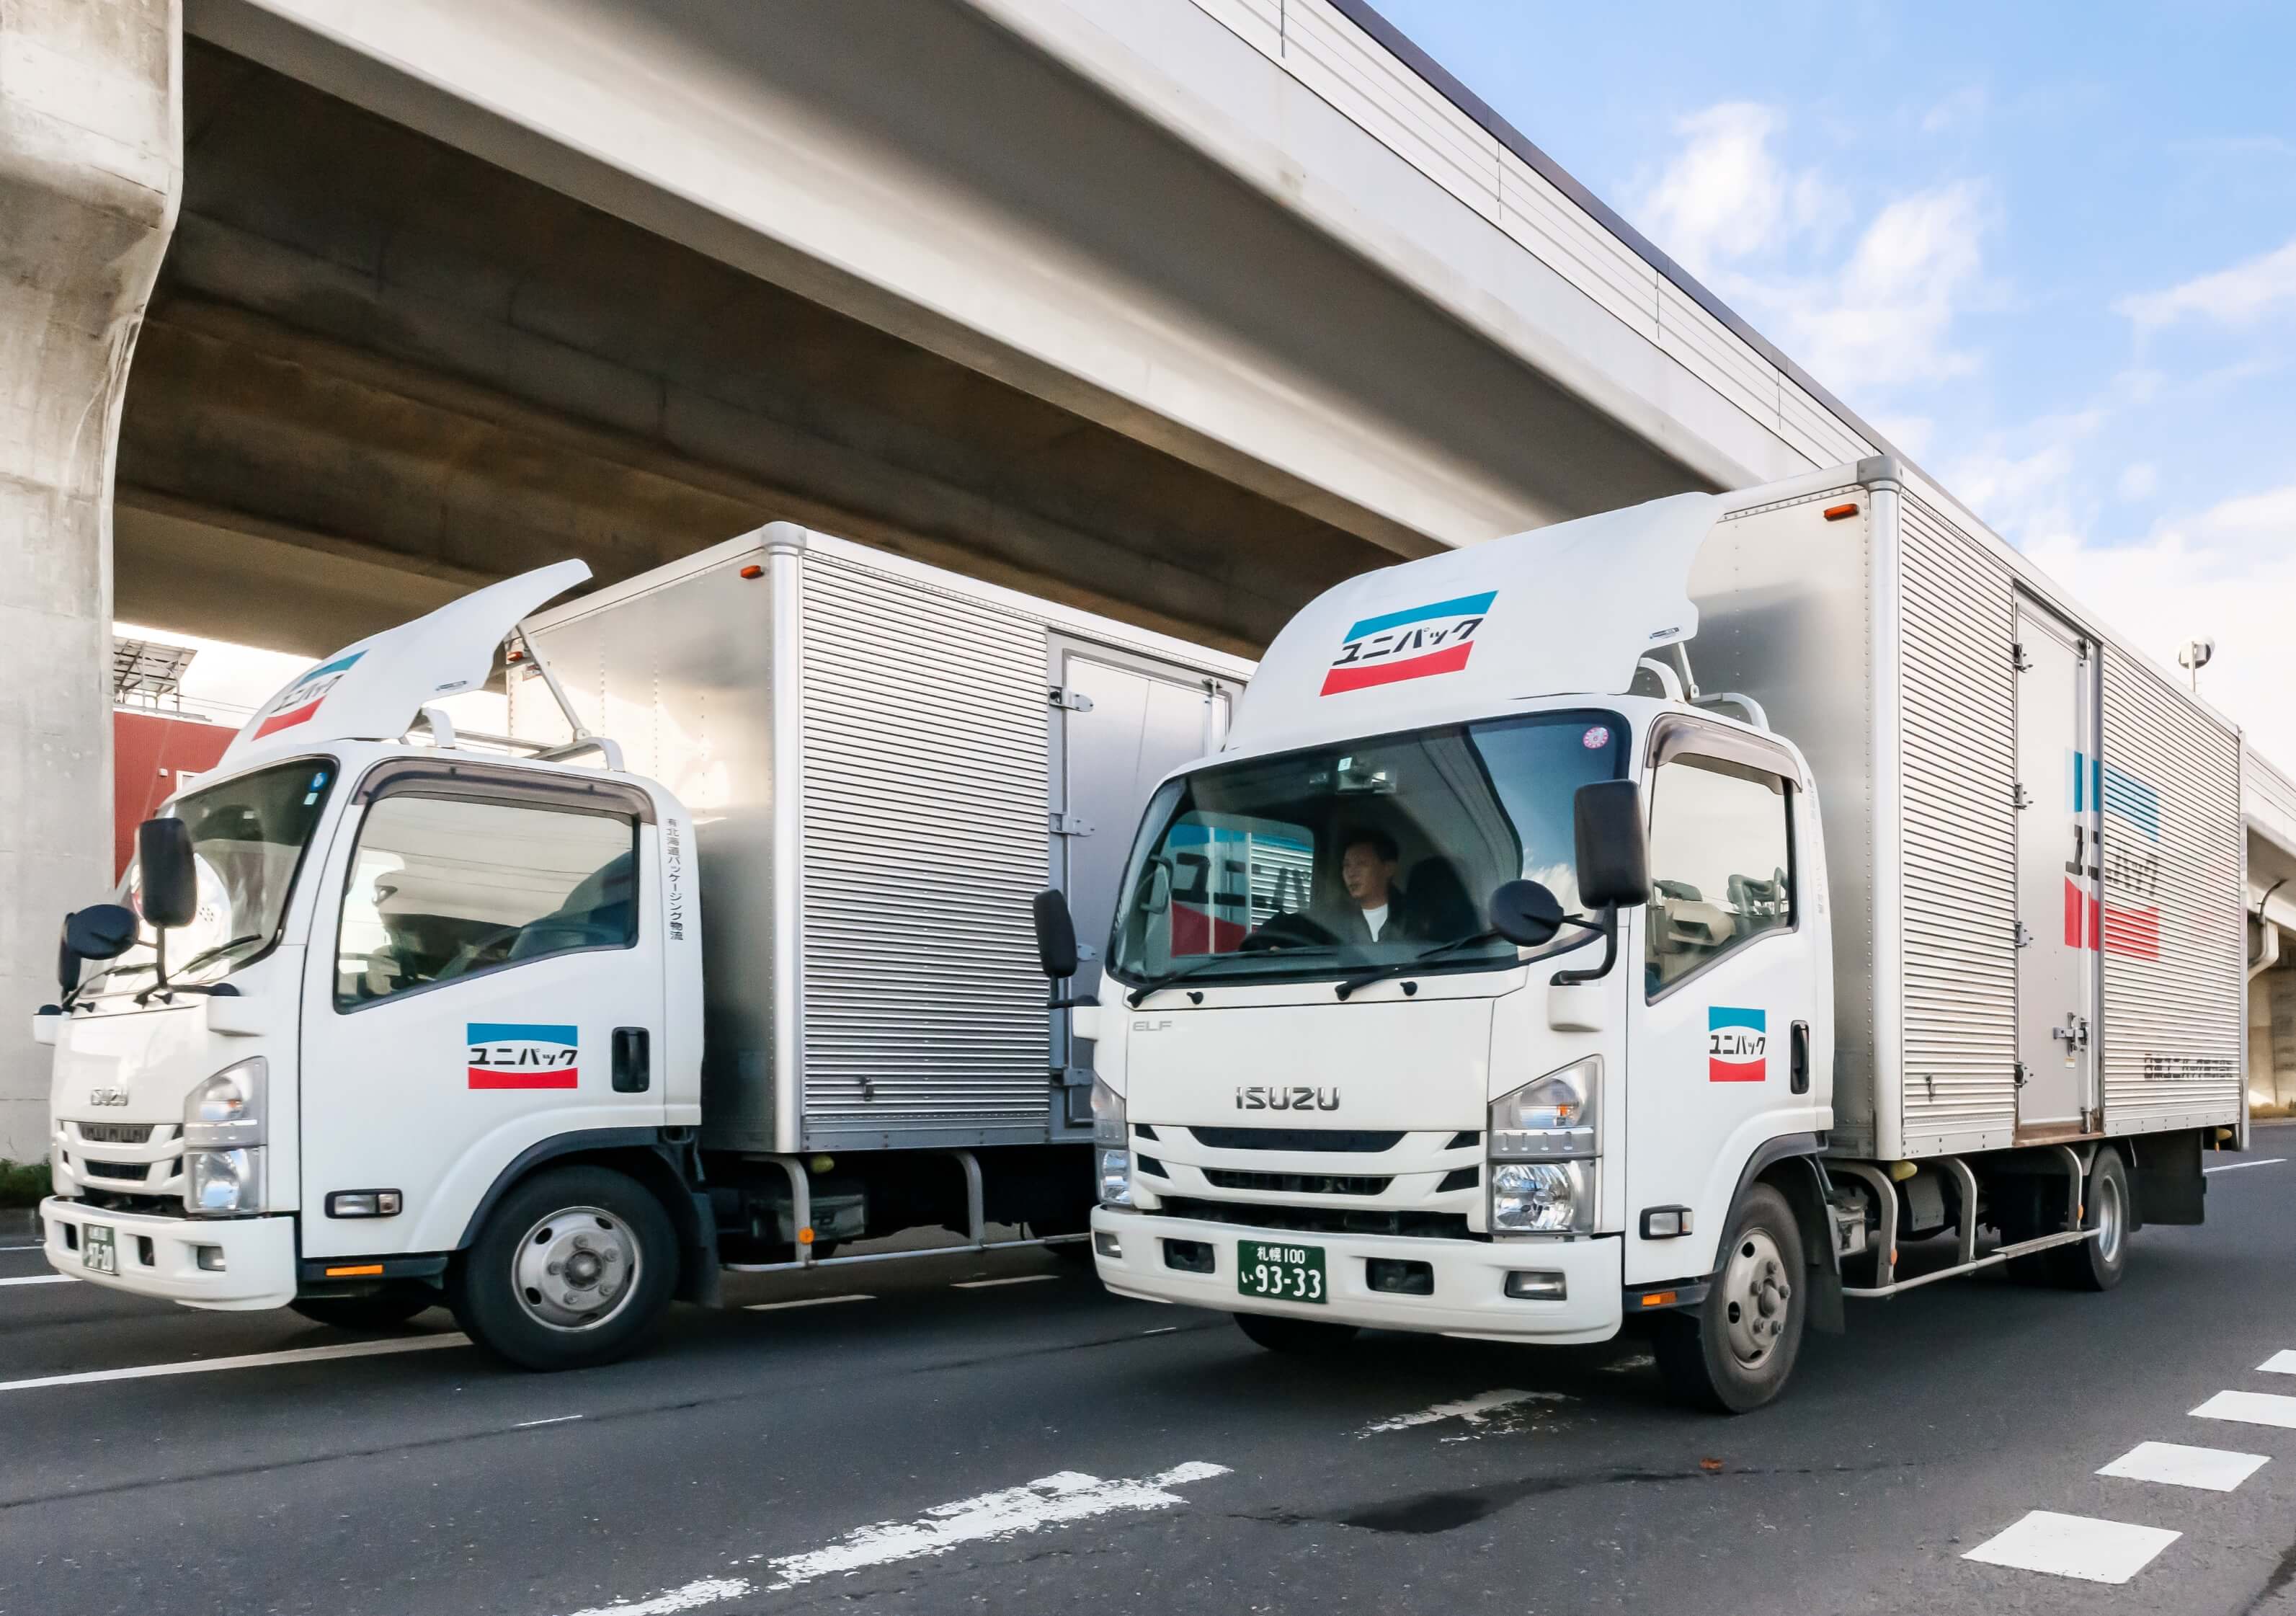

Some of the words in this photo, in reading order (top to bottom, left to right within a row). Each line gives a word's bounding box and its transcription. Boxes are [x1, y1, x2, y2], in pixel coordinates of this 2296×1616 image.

[1332, 617, 1484, 667] ユニパック
[1133, 1021, 1173, 1031] ELF
[1709, 1034, 1766, 1055] ユニパック
[468, 1048, 578, 1065] ユニパック
[1236, 1086, 1340, 1111] ISUZU
